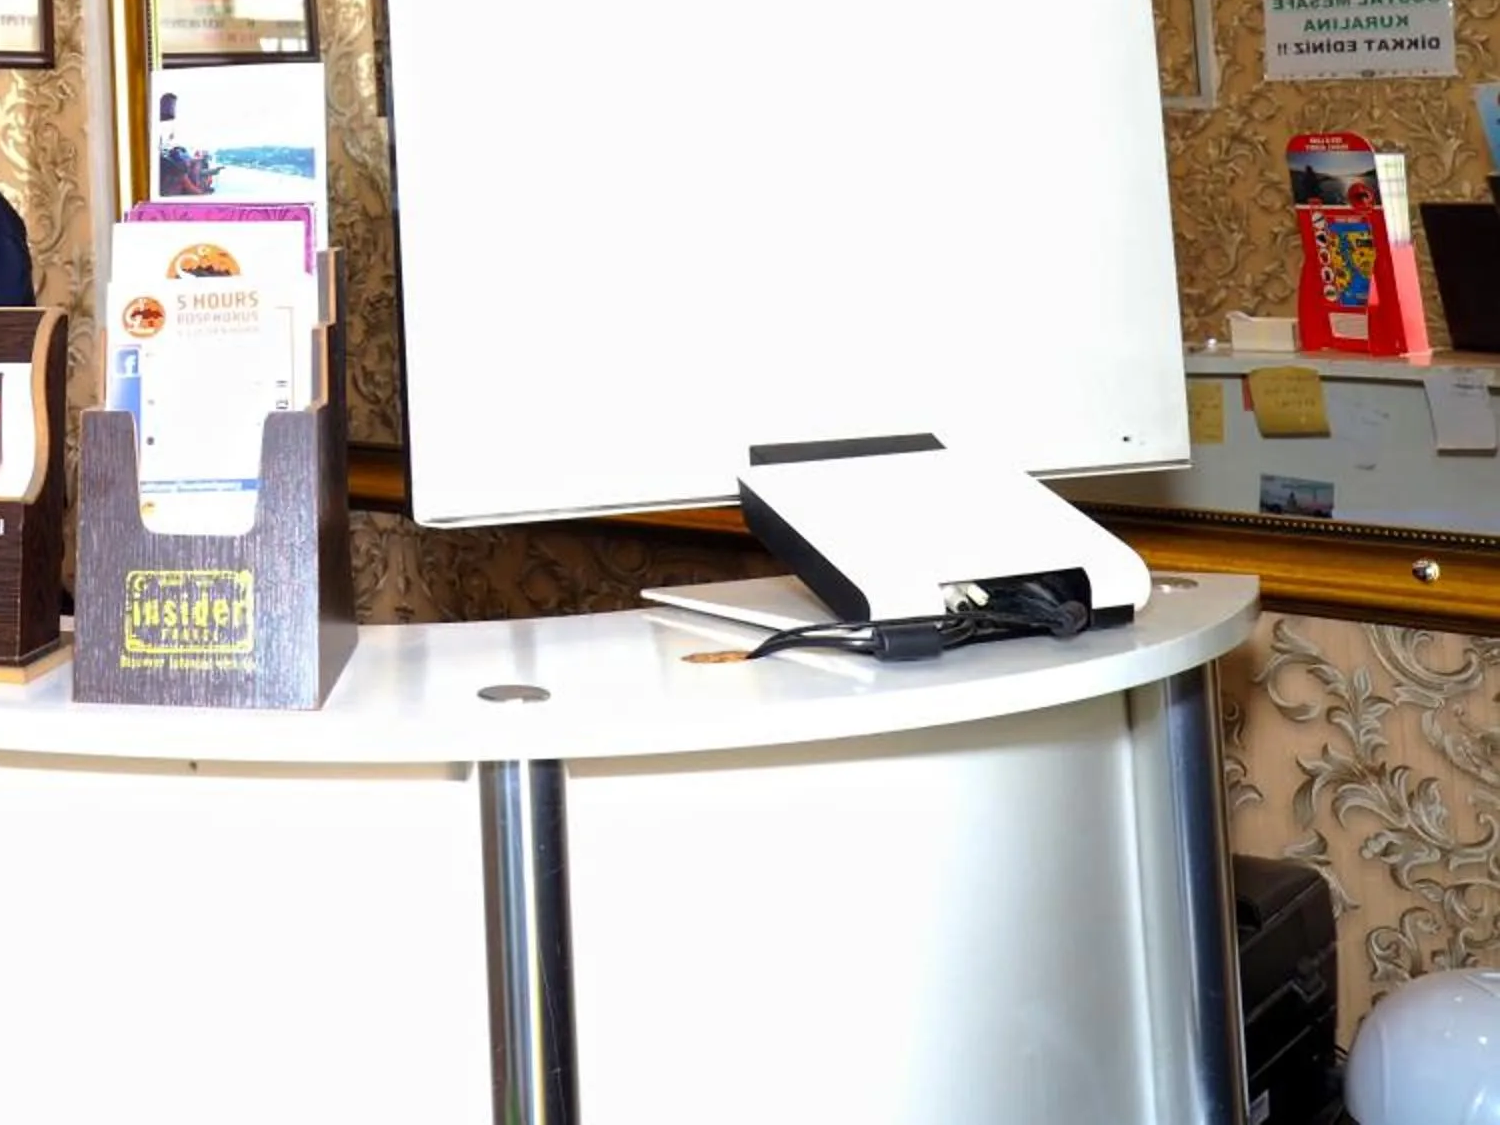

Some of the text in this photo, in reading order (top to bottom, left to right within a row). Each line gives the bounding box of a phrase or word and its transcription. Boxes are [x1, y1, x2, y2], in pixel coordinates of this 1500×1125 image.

[176, 290, 260, 311] 5 HOURS
[132, 590, 247, 628] insider
